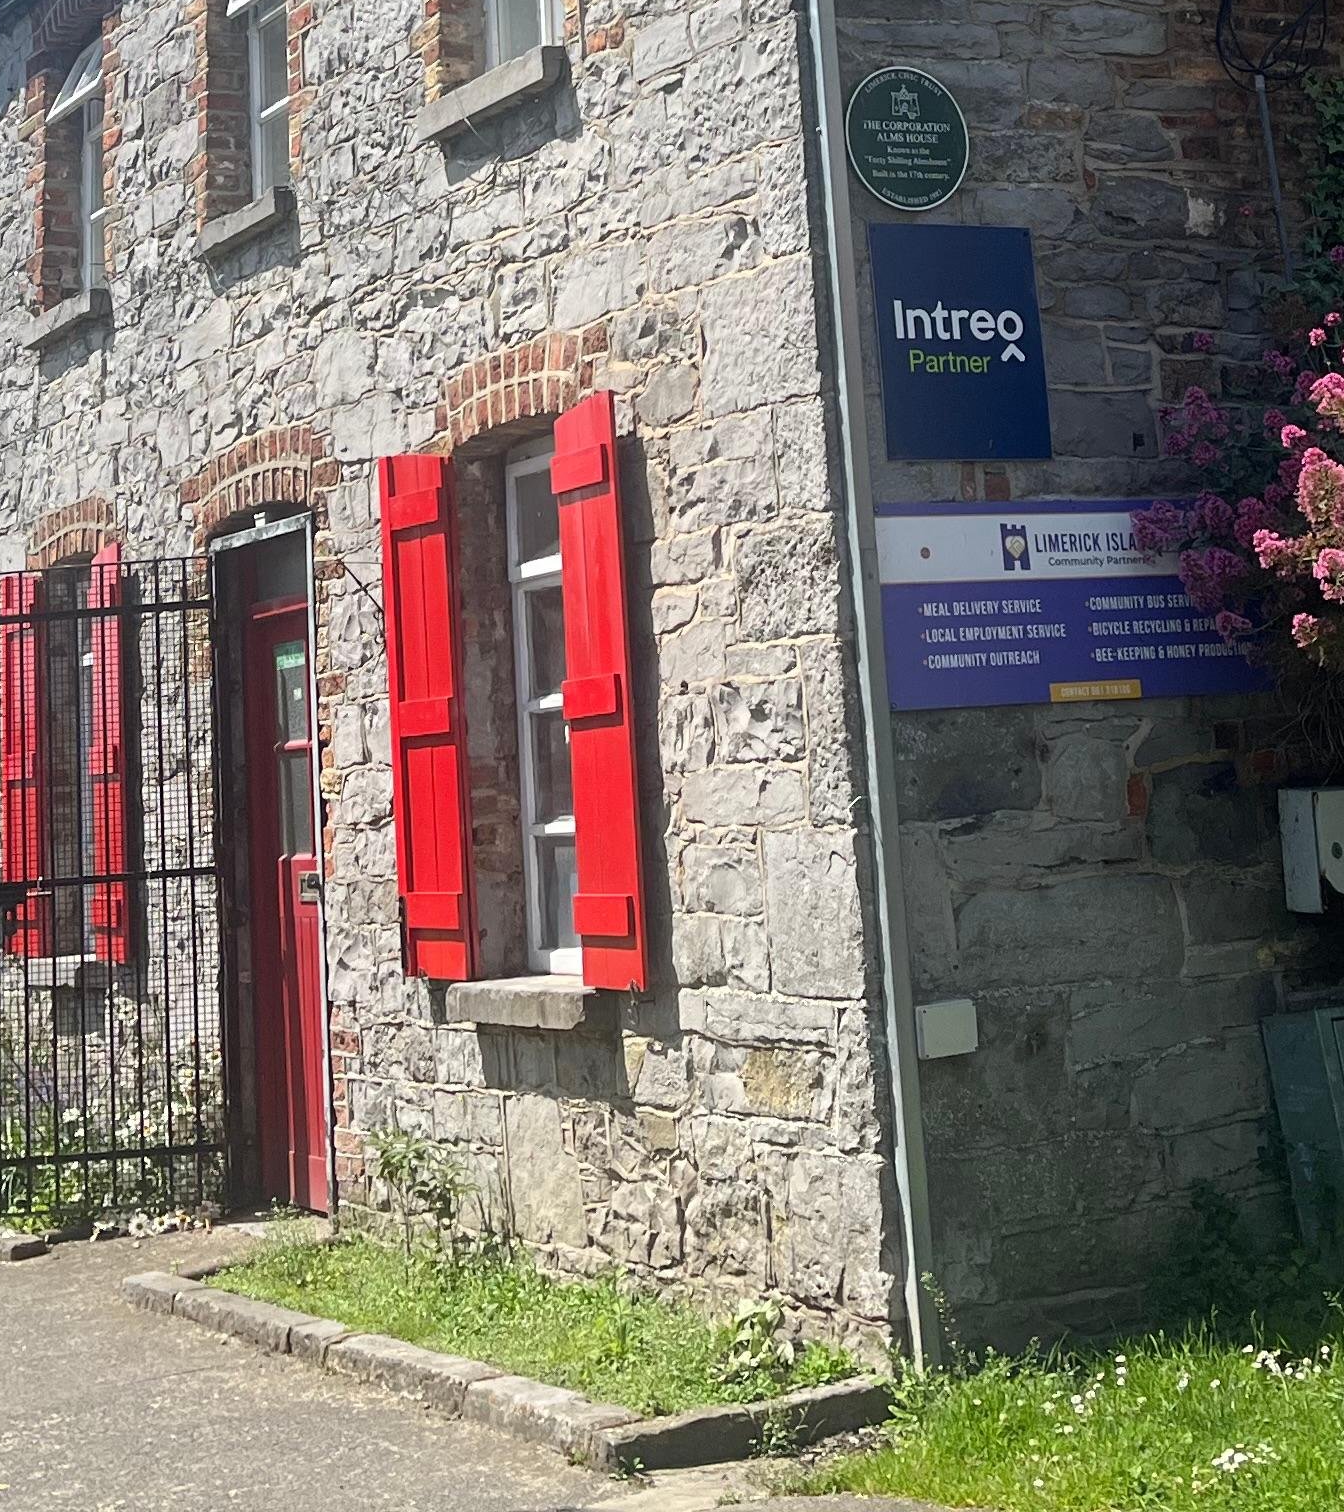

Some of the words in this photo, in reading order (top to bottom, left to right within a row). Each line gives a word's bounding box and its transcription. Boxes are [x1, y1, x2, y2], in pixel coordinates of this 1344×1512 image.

[864, 71, 897, 93] LIMERICK
[920, 78, 943, 97] TRUST
[863, 120, 881, 130] THE
[882, 120, 951, 132] CORPORATION
[877, 132, 904, 142] ALMS
[906, 133, 939, 144] HOUSE
[893, 299, 1024, 342] Intreo
[909, 349, 991, 374] Partner
[1034, 533, 1102, 553] LIMERICK
[1048, 555, 1104, 568] Community
[923, 602, 951, 617] MEAL
[953, 600, 999, 616] DELIVERY
[1002, 599, 1042, 614] SERVICE
[1089, 595, 1145, 611] COMMUNITY
[1147, 594, 1166, 609] BUS
[925, 627, 957, 643] LOCAL
[960, 625, 1024, 642] EMPLOYMENT
[1026, 623, 1066, 639] SERVICE
[1092, 620, 1130, 636] BICYCLE
[1132, 619, 1182, 635] RECYCLING
[1184, 619, 1191, 633] &
[928, 653, 987, 669] COMMUNITY
[989, 650, 1040, 666] OUTREACH
[1095, 646, 1156, 663] BEE-KEEPING
[1158, 646, 1165, 660] &
[1166, 644, 1196, 660] HONEY
[1060, 686, 1090, 697] CONTACT
